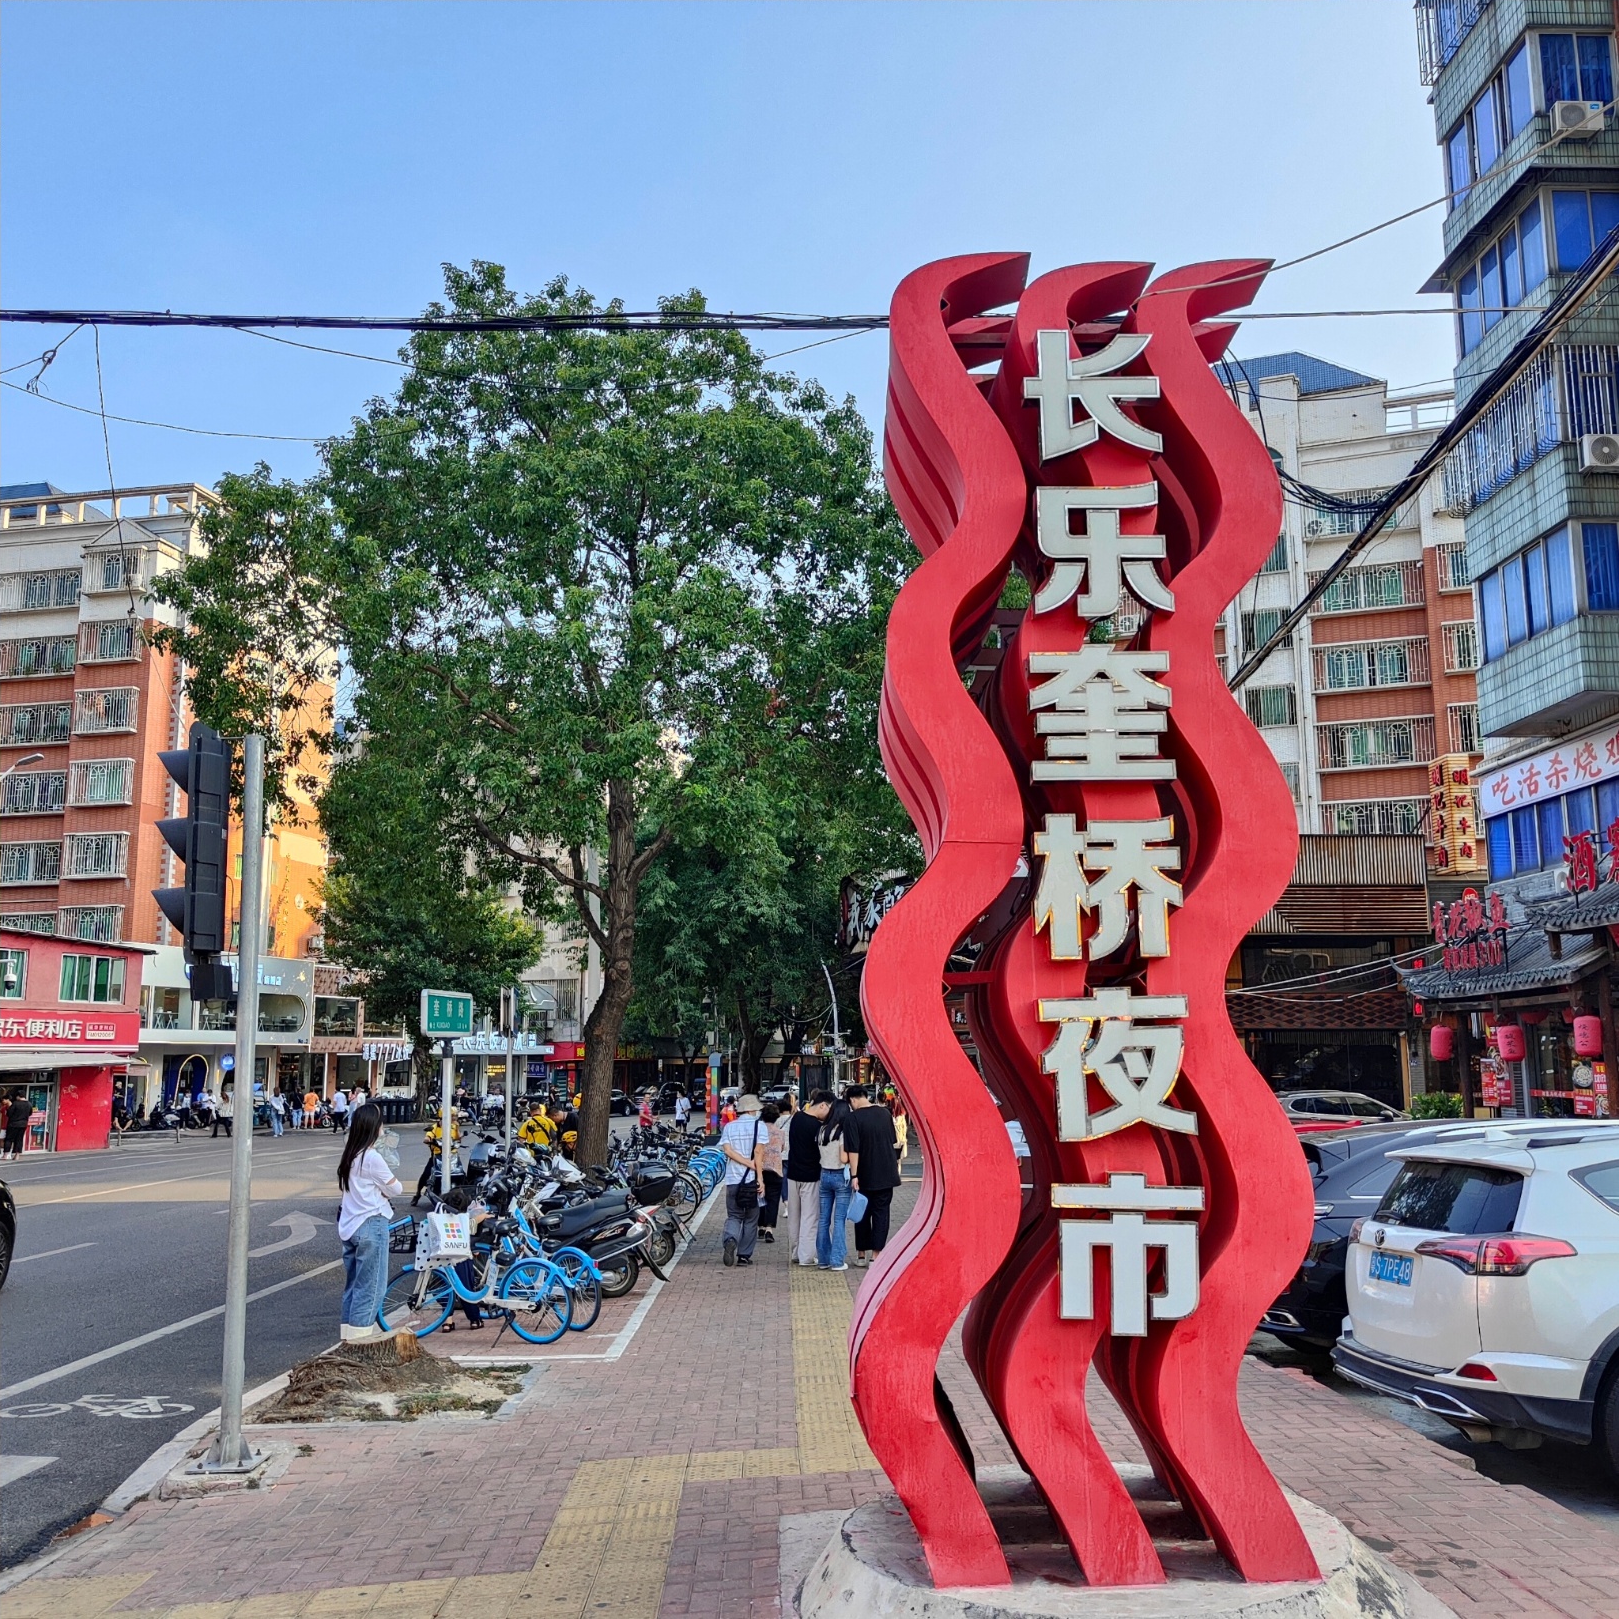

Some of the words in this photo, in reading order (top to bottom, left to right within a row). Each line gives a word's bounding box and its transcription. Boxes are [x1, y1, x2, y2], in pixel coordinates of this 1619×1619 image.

[1024, 329, 1205, 1339] 长乐奎桥夜市
[1452, 768, 1473, 858] 明记牛肉
[444, 1241, 468, 1249] SANFU
